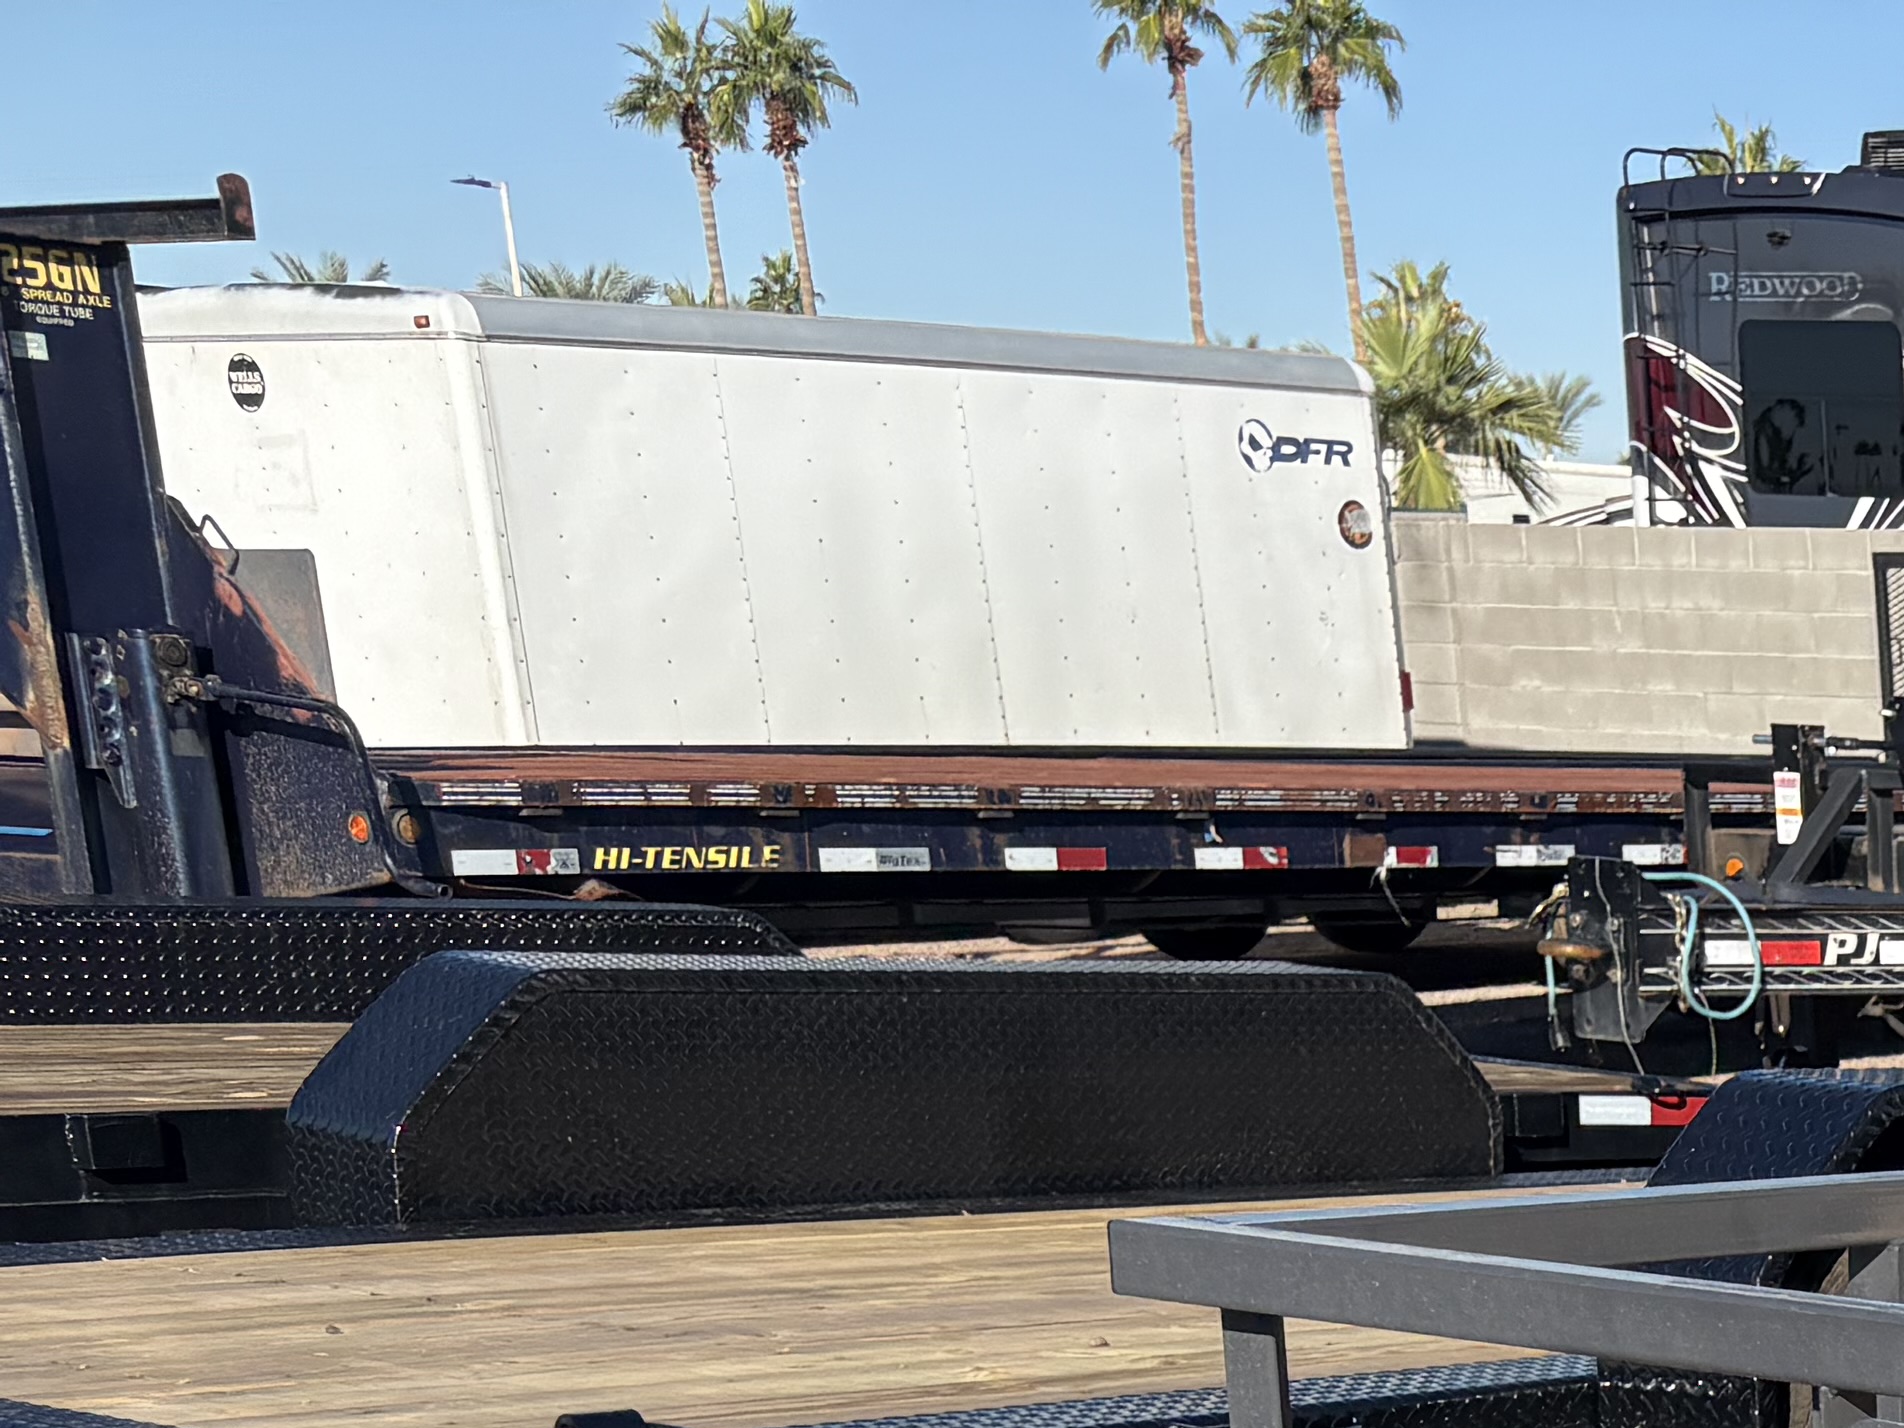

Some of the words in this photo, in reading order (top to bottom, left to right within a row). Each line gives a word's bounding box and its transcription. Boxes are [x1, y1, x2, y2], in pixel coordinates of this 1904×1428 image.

[21, 287, 73, 304] SPREAD
[78, 294, 112, 308] AXLE
[1709, 271, 1863, 301] REDWOOD
[63, 305, 94, 320] TUBE
[229, 371, 261, 383] WELLS
[231, 383, 263, 395] CARGO
[1270, 436, 1353, 467] DFR
[593, 844, 781, 871] HI-TENSILE
[1823, 933, 1880, 965] PJ
